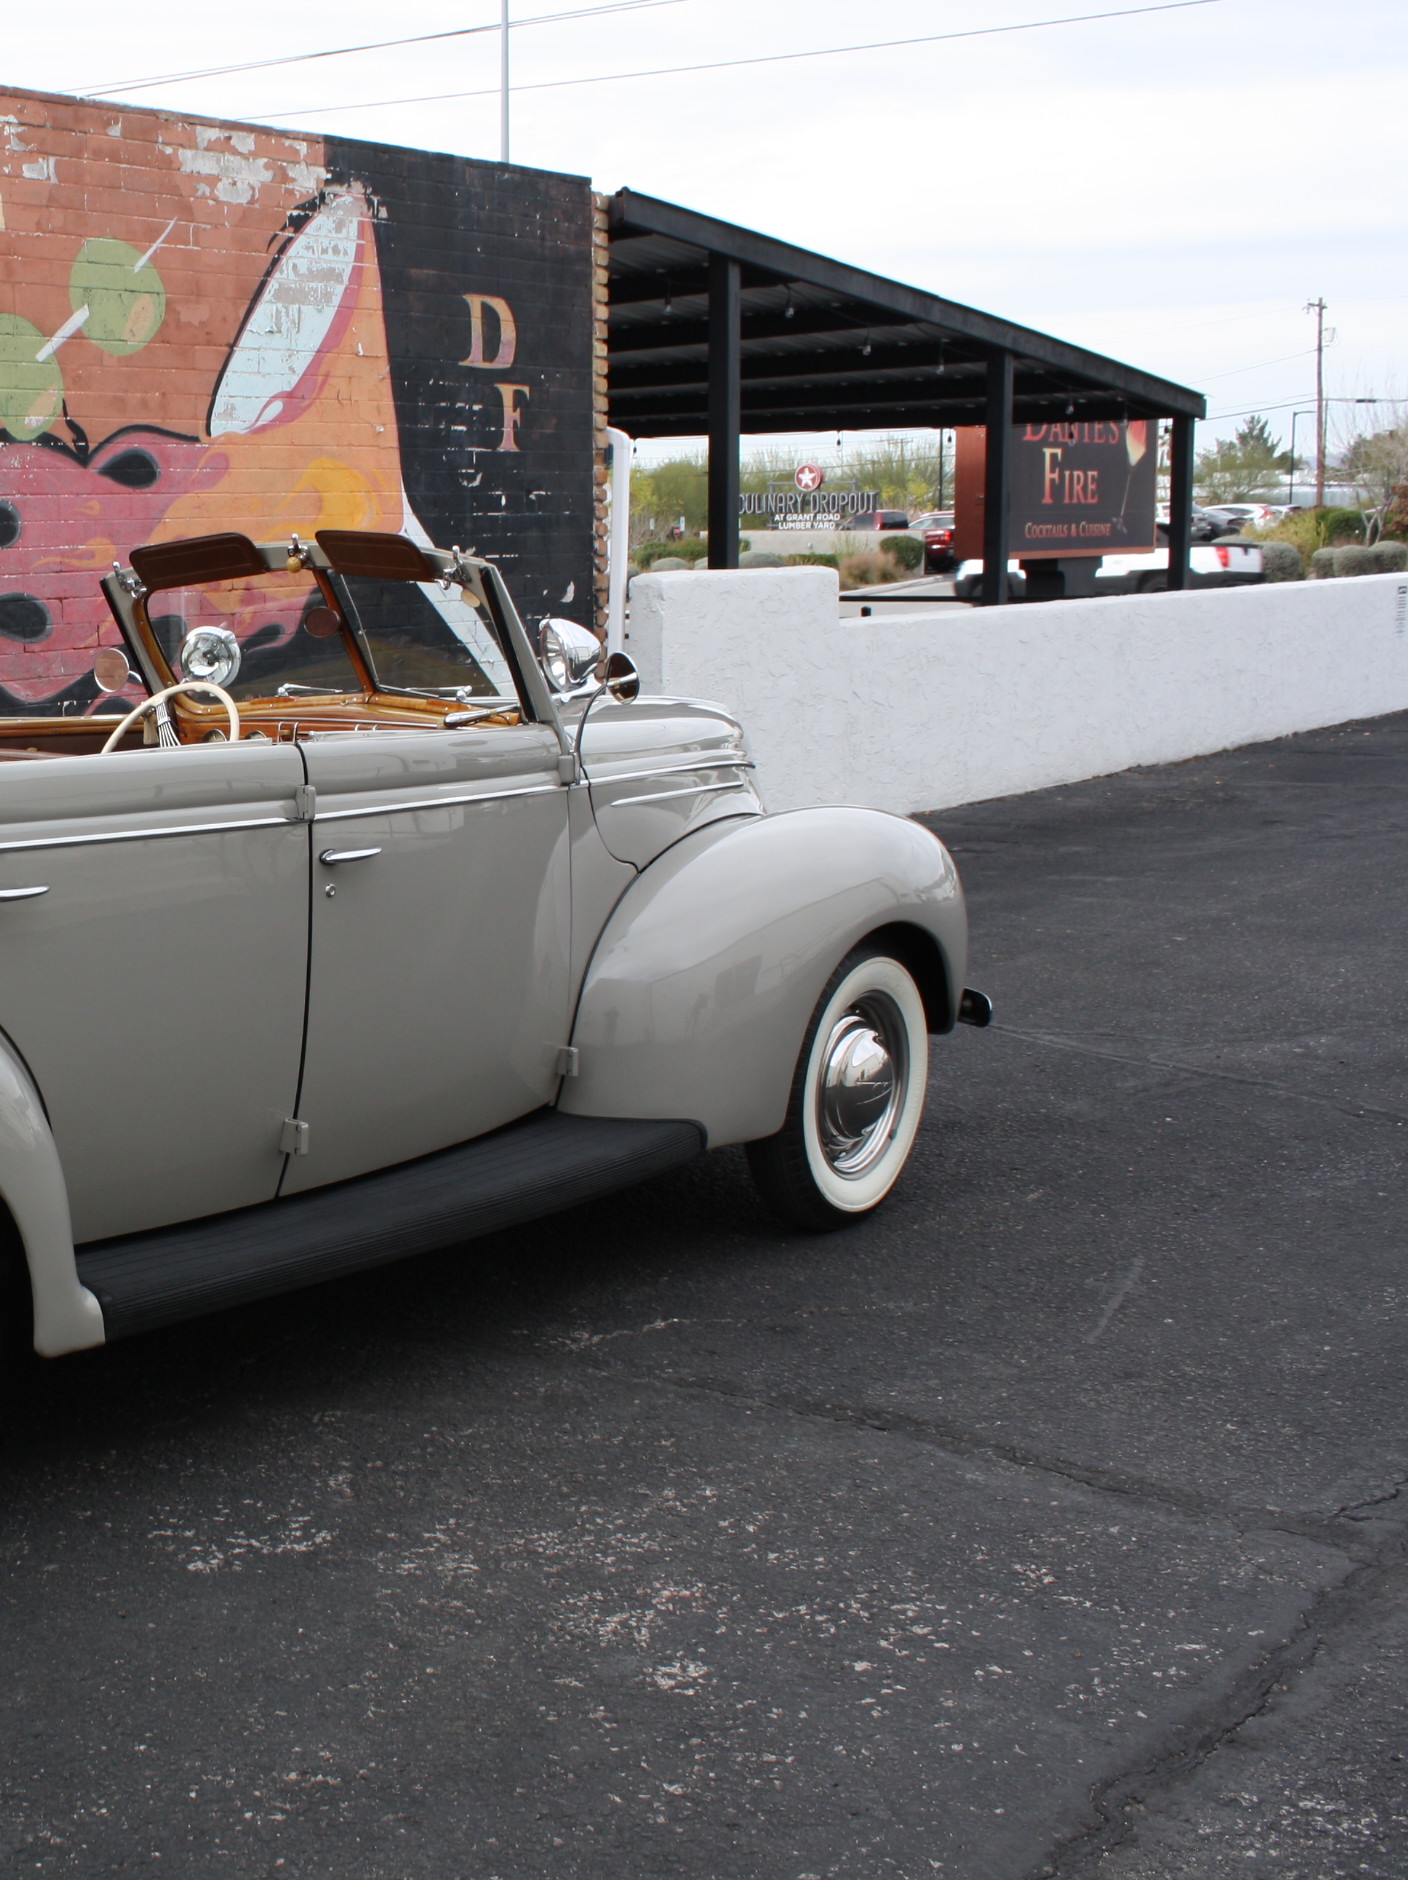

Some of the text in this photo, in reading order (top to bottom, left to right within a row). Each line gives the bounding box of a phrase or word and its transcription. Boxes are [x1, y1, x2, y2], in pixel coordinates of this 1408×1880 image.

[458, 293, 517, 369] D
[494, 382, 530, 452] F
[1041, 446, 1100, 504] FIRE
[739, 491, 879, 515] CULINARY DROPOUT
[773, 512, 841, 522] AT GRANT ROAD
[778, 520, 836, 530] LUMBER YARD
[1024, 521, 1069, 538] COCKTAILS
[1079, 520, 1113, 537] CUISINE
